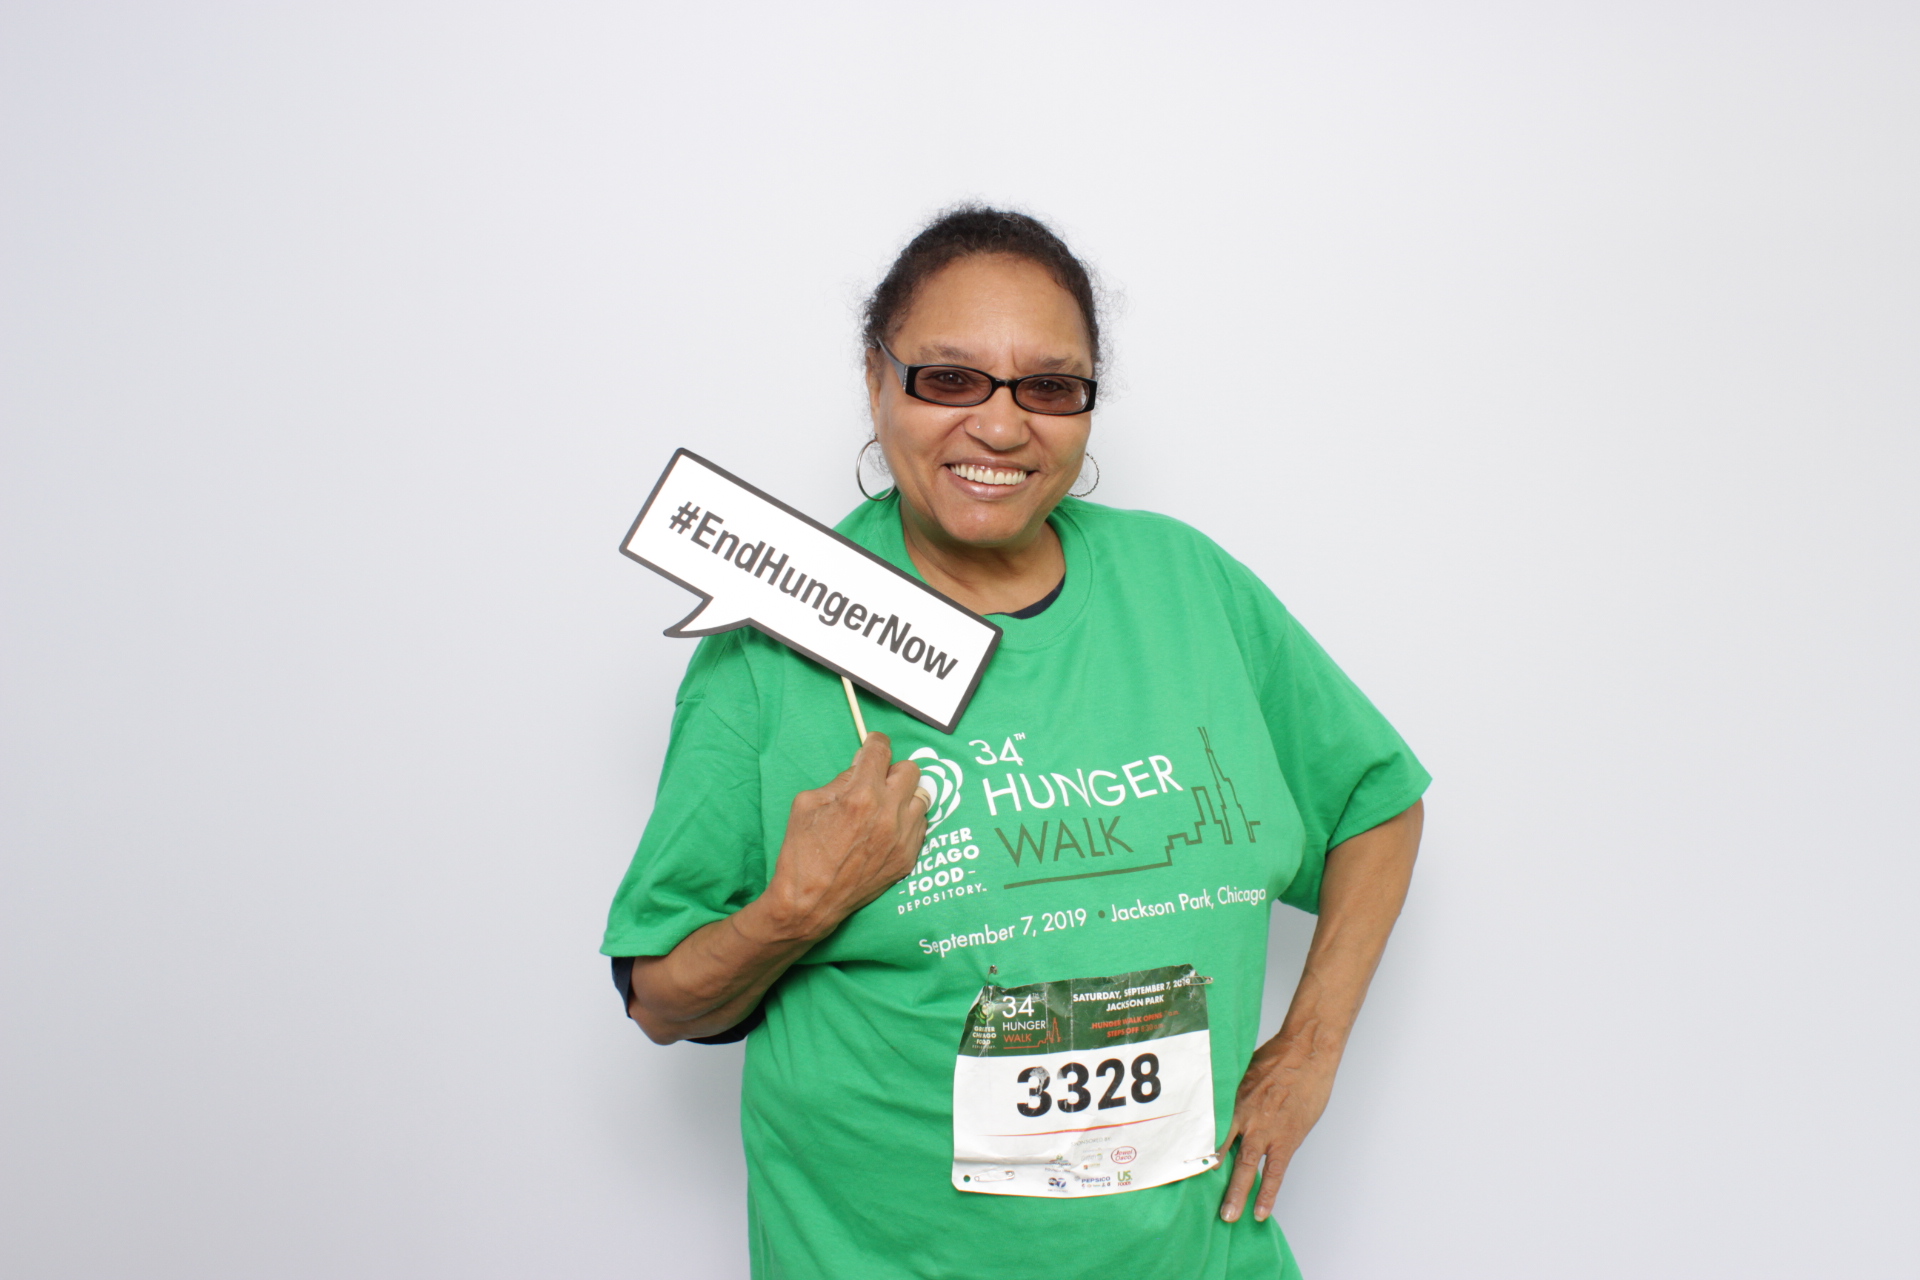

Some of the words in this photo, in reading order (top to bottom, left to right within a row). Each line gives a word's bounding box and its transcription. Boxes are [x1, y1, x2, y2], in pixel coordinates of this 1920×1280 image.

[668, 501, 958, 680] #EndHungerNow
[982, 755, 1184, 816] HUNGER
[920, 827, 973, 857] EATER
[994, 815, 1135, 867] WALK
[908, 845, 980, 877] ICAGO
[1111, 899, 1176, 922] Jackson
[1178, 888, 1214, 911] Park,
[1217, 885, 1267, 906] Chicago
[919, 924, 1015, 958] September
[1020, 915, 1036, 938] 7,
[1041, 908, 1087, 932] 2019
[1072, 990, 1122, 1002] SATURDAY,
[1124, 982, 1165, 997] SEPTEMBER
[1106, 998, 1144, 1012] JACKSON
[1145, 995, 1164, 1005] PARK
[1002, 1020, 1046, 1031] HUNGER
[1091, 1019, 1122, 1029] HUNGER
[1122, 1016, 1143, 1025] WALK
[1143, 1012, 1163, 1022] OPENS
[1107, 1029, 1125, 1038] STEPS
[1125, 1026, 1139, 1035] OFF
[1003, 1033, 1033, 1043] WALK
[1017, 1053, 1161, 1118] 3328
